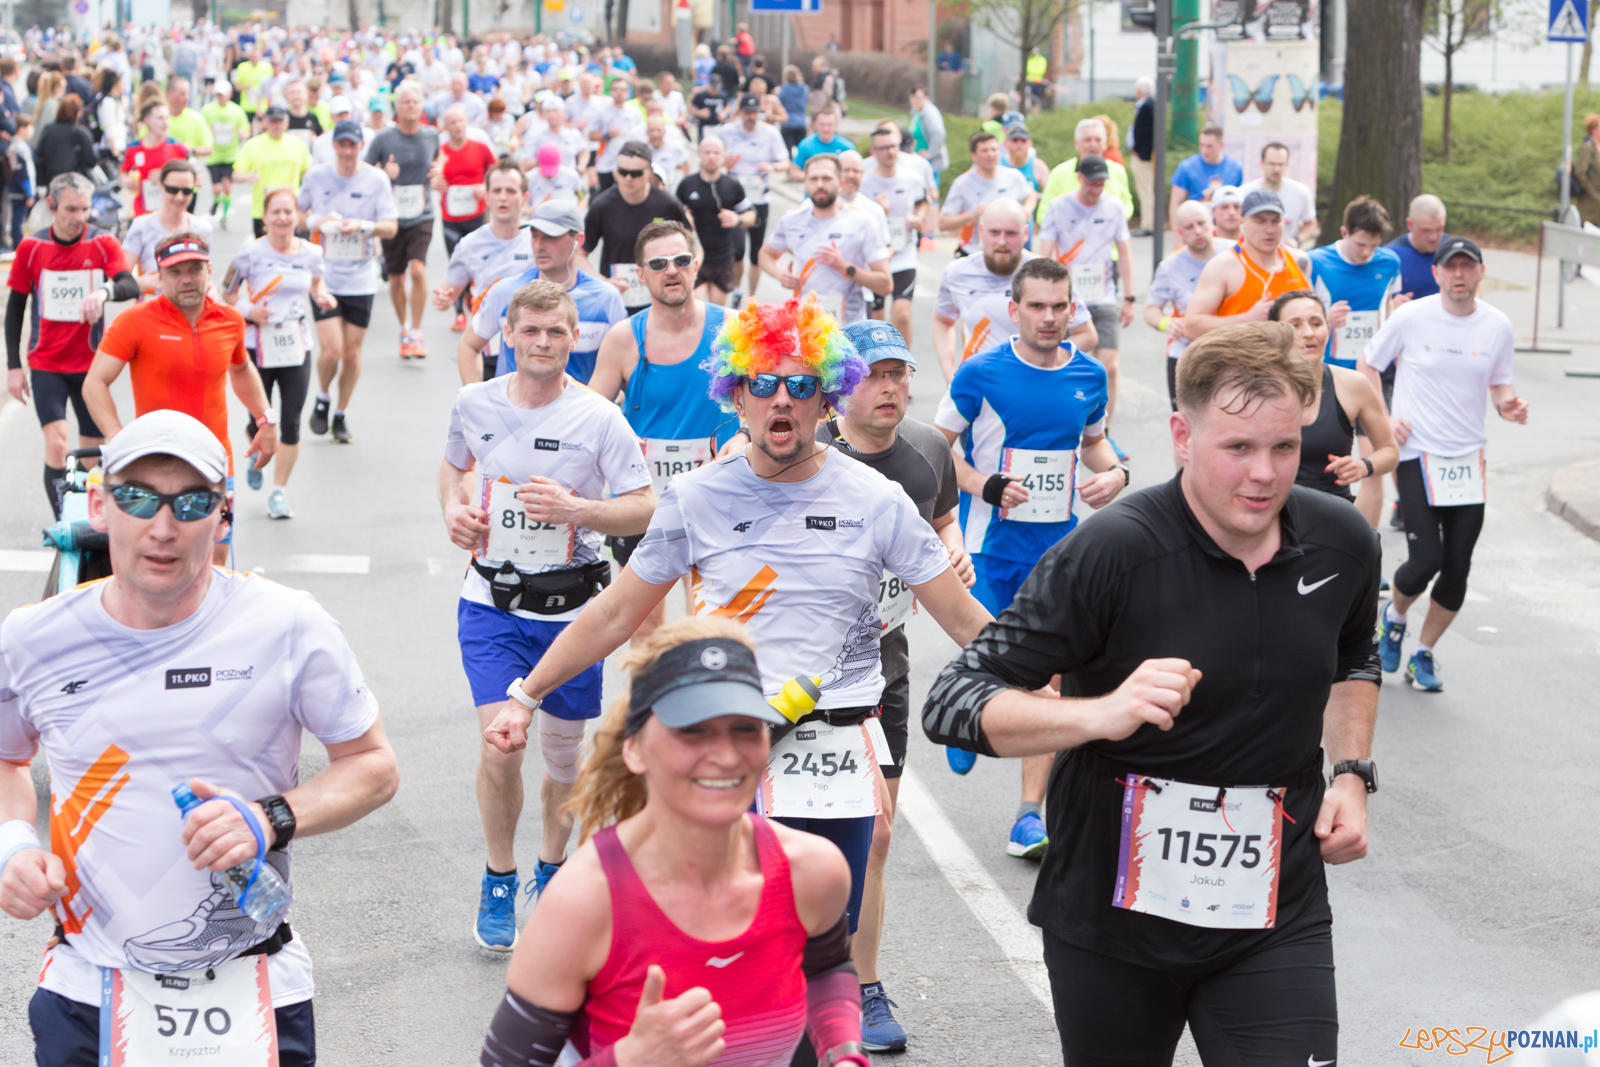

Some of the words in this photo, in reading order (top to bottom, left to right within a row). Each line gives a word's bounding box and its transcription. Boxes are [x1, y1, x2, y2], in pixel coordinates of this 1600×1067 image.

[52, 287, 84, 299] 5991
[1345, 327, 1373, 339] 2518
[273, 335, 295, 347] 185
[1439, 466, 1472, 481] 7671
[1022, 473, 1065, 491] 4155
[733, 521, 752, 533] 4F
[171, 672, 209, 684] 11.PKO
[60, 680, 88, 694] 4F
[781, 750, 858, 777] 2454
[813, 782, 829, 791] Filip
[1157, 827, 1262, 869] 11575
[1189, 874, 1226, 887] Jakub
[154, 1004, 231, 1037] 570
[169, 1044, 221, 1059] Krzysztof
